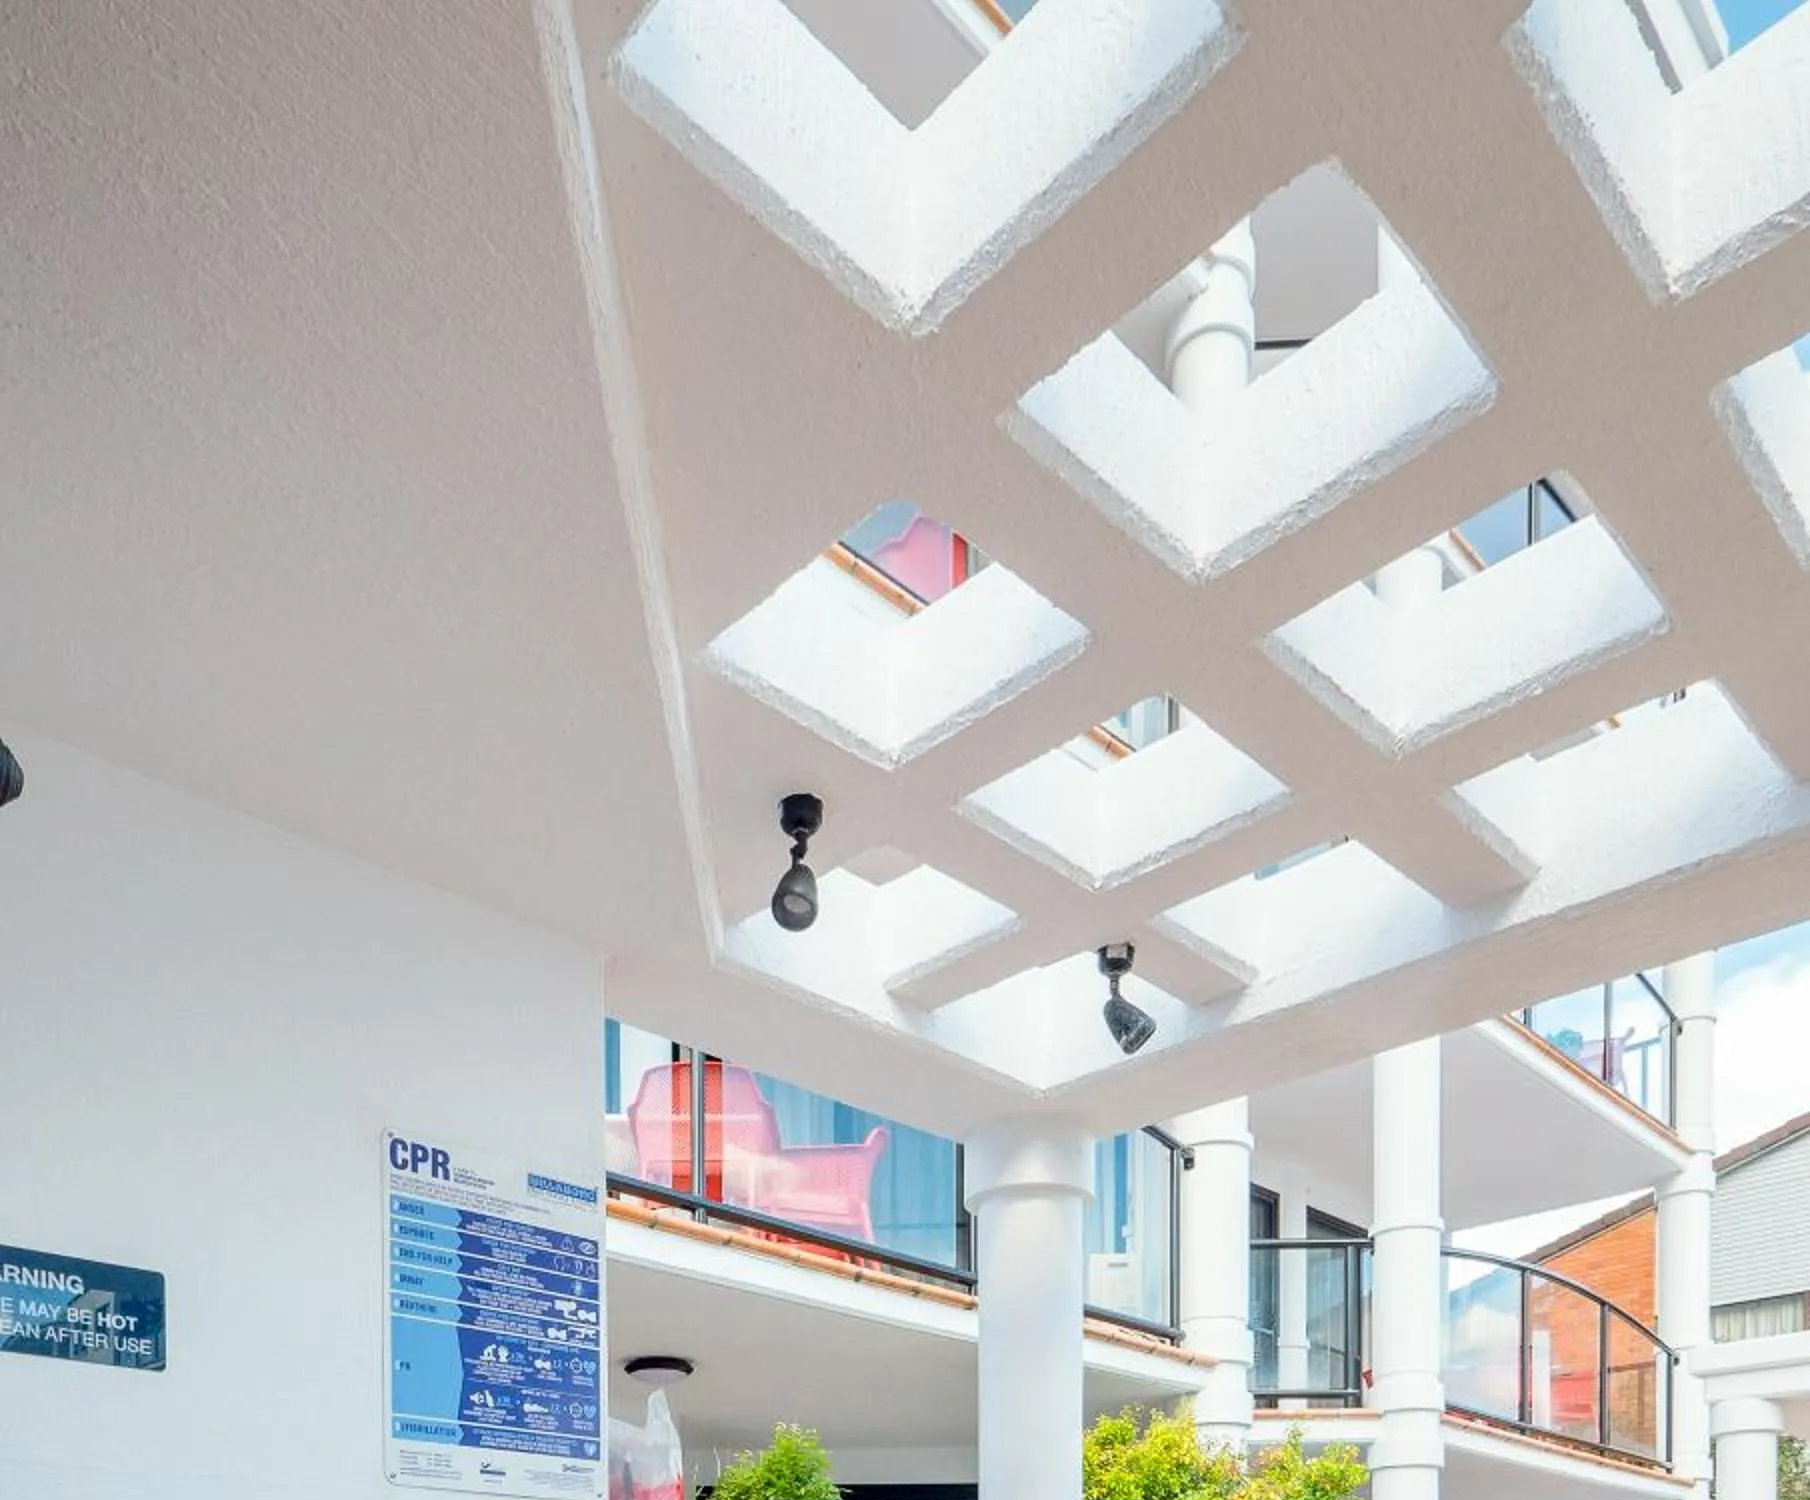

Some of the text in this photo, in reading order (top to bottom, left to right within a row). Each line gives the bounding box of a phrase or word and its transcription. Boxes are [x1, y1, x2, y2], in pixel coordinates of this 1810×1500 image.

[390, 1138, 450, 1180] CPR
[0, 1263, 85, 1294] RNING
[19, 1300, 61, 1321] MAY
[67, 1308, 93, 1325] BE
[97, 1312, 138, 1332] HOT
[0, 1319, 152, 1355] EAN AFTER USE
